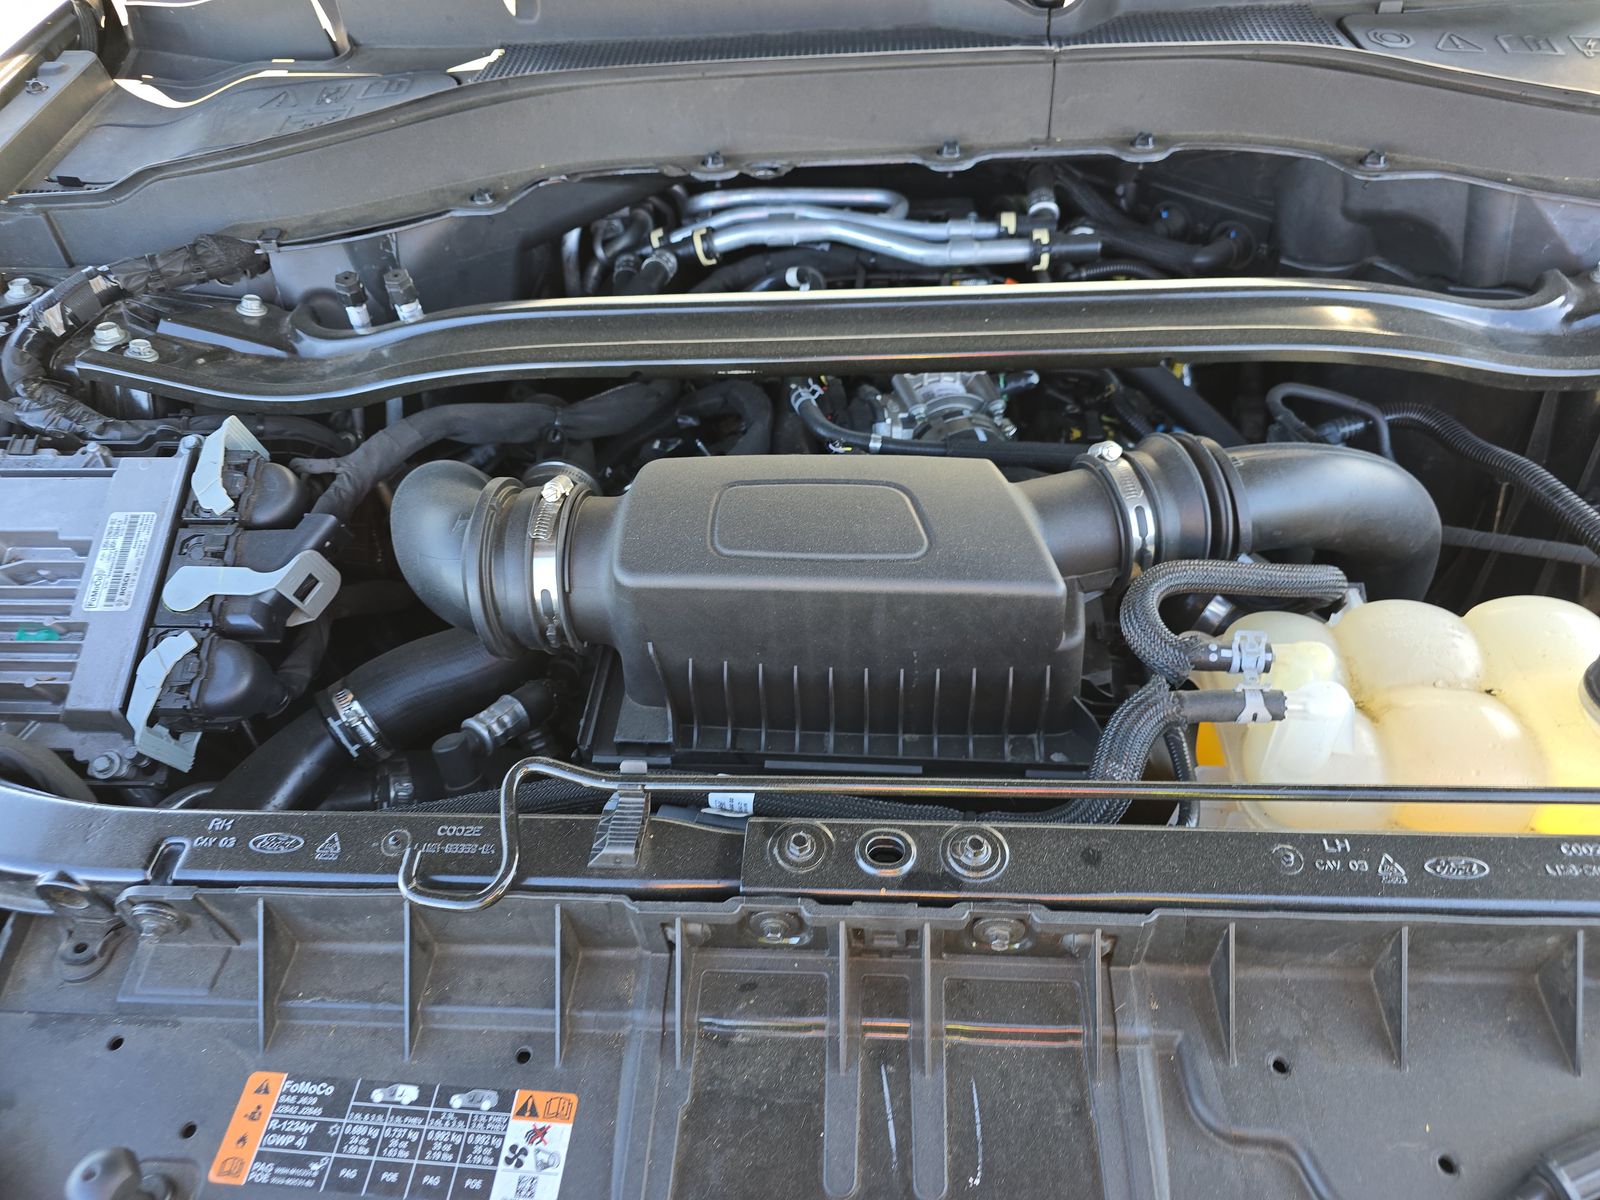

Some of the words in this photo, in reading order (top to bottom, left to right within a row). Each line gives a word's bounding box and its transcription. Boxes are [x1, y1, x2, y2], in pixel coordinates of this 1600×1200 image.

[119, 572, 131, 596] BOSCH
[88, 575, 103, 607] FoMoCo
[254, 834, 299, 851] Ford
[1322, 838, 1351, 853] LH
[1433, 858, 1483, 877] Ford
[282, 1080, 334, 1096] FoMoCo
[278, 1094, 297, 1104] SAE
[268, 1119, 318, 1135] R-1234yf
[252, 1162, 274, 1173] PAG
[339, 1168, 358, 1179] PAG
[248, 1171, 272, 1183] POE
[380, 1171, 400, 1183] POE
[422, 1175, 441, 1186] PAG
[464, 1179, 484, 1190] POE
